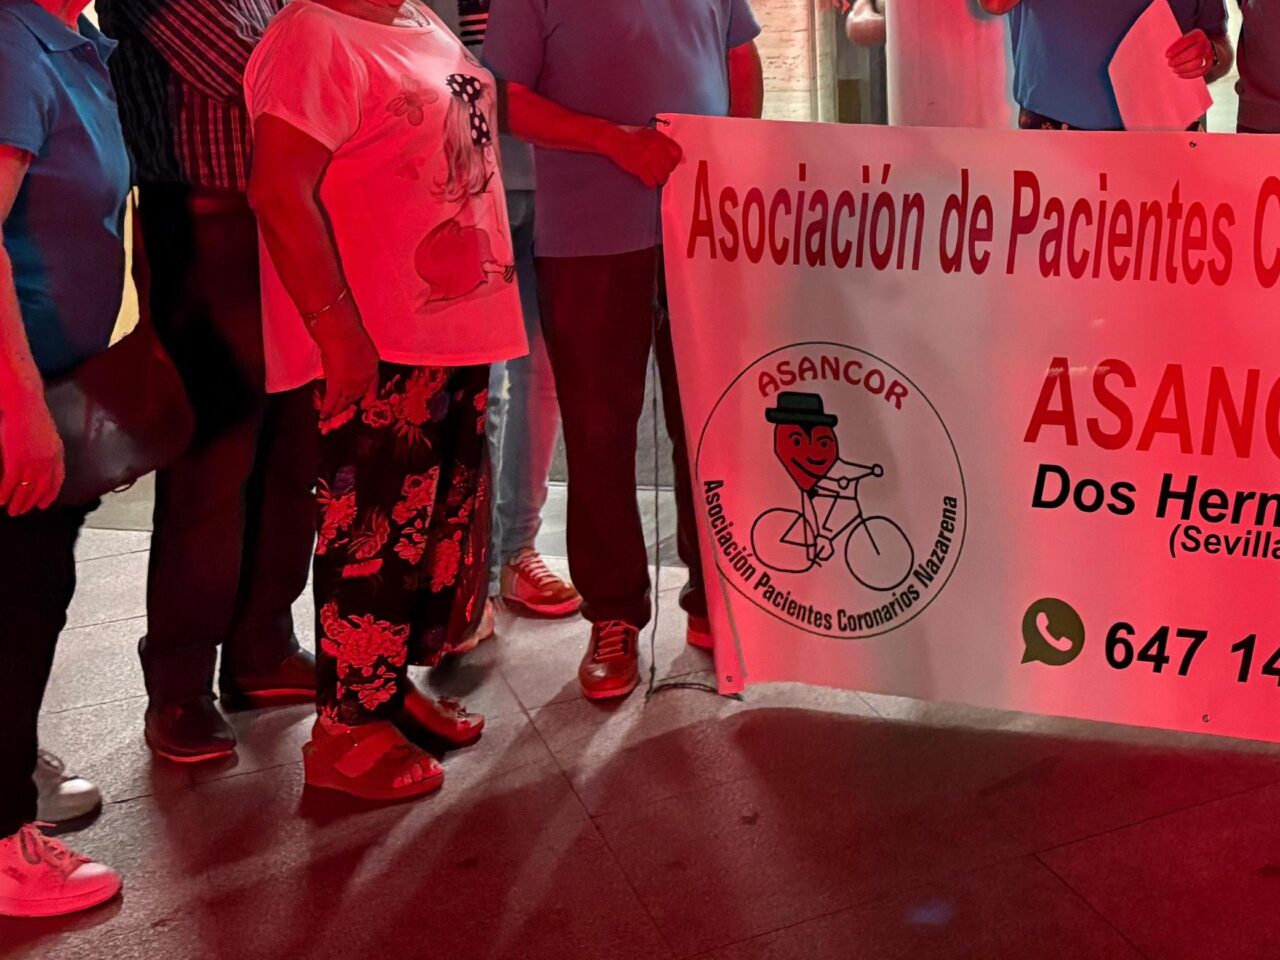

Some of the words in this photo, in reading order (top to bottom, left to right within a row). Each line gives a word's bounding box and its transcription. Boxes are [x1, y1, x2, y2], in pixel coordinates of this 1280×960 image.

[686, 159, 926, 273] Asociación
[939, 168, 994, 276] de
[1005, 169, 1236, 289] Pacientes
[757, 355, 910, 411] ASANCOR
[1031, 464, 1137, 516] Dos
[703, 478, 757, 583] Asociación
[752, 571, 833, 632] Pacientes
[836, 581, 921, 633] Coronarios
[911, 494, 958, 590] Nazarena
[1104, 620, 1209, 678] 647
